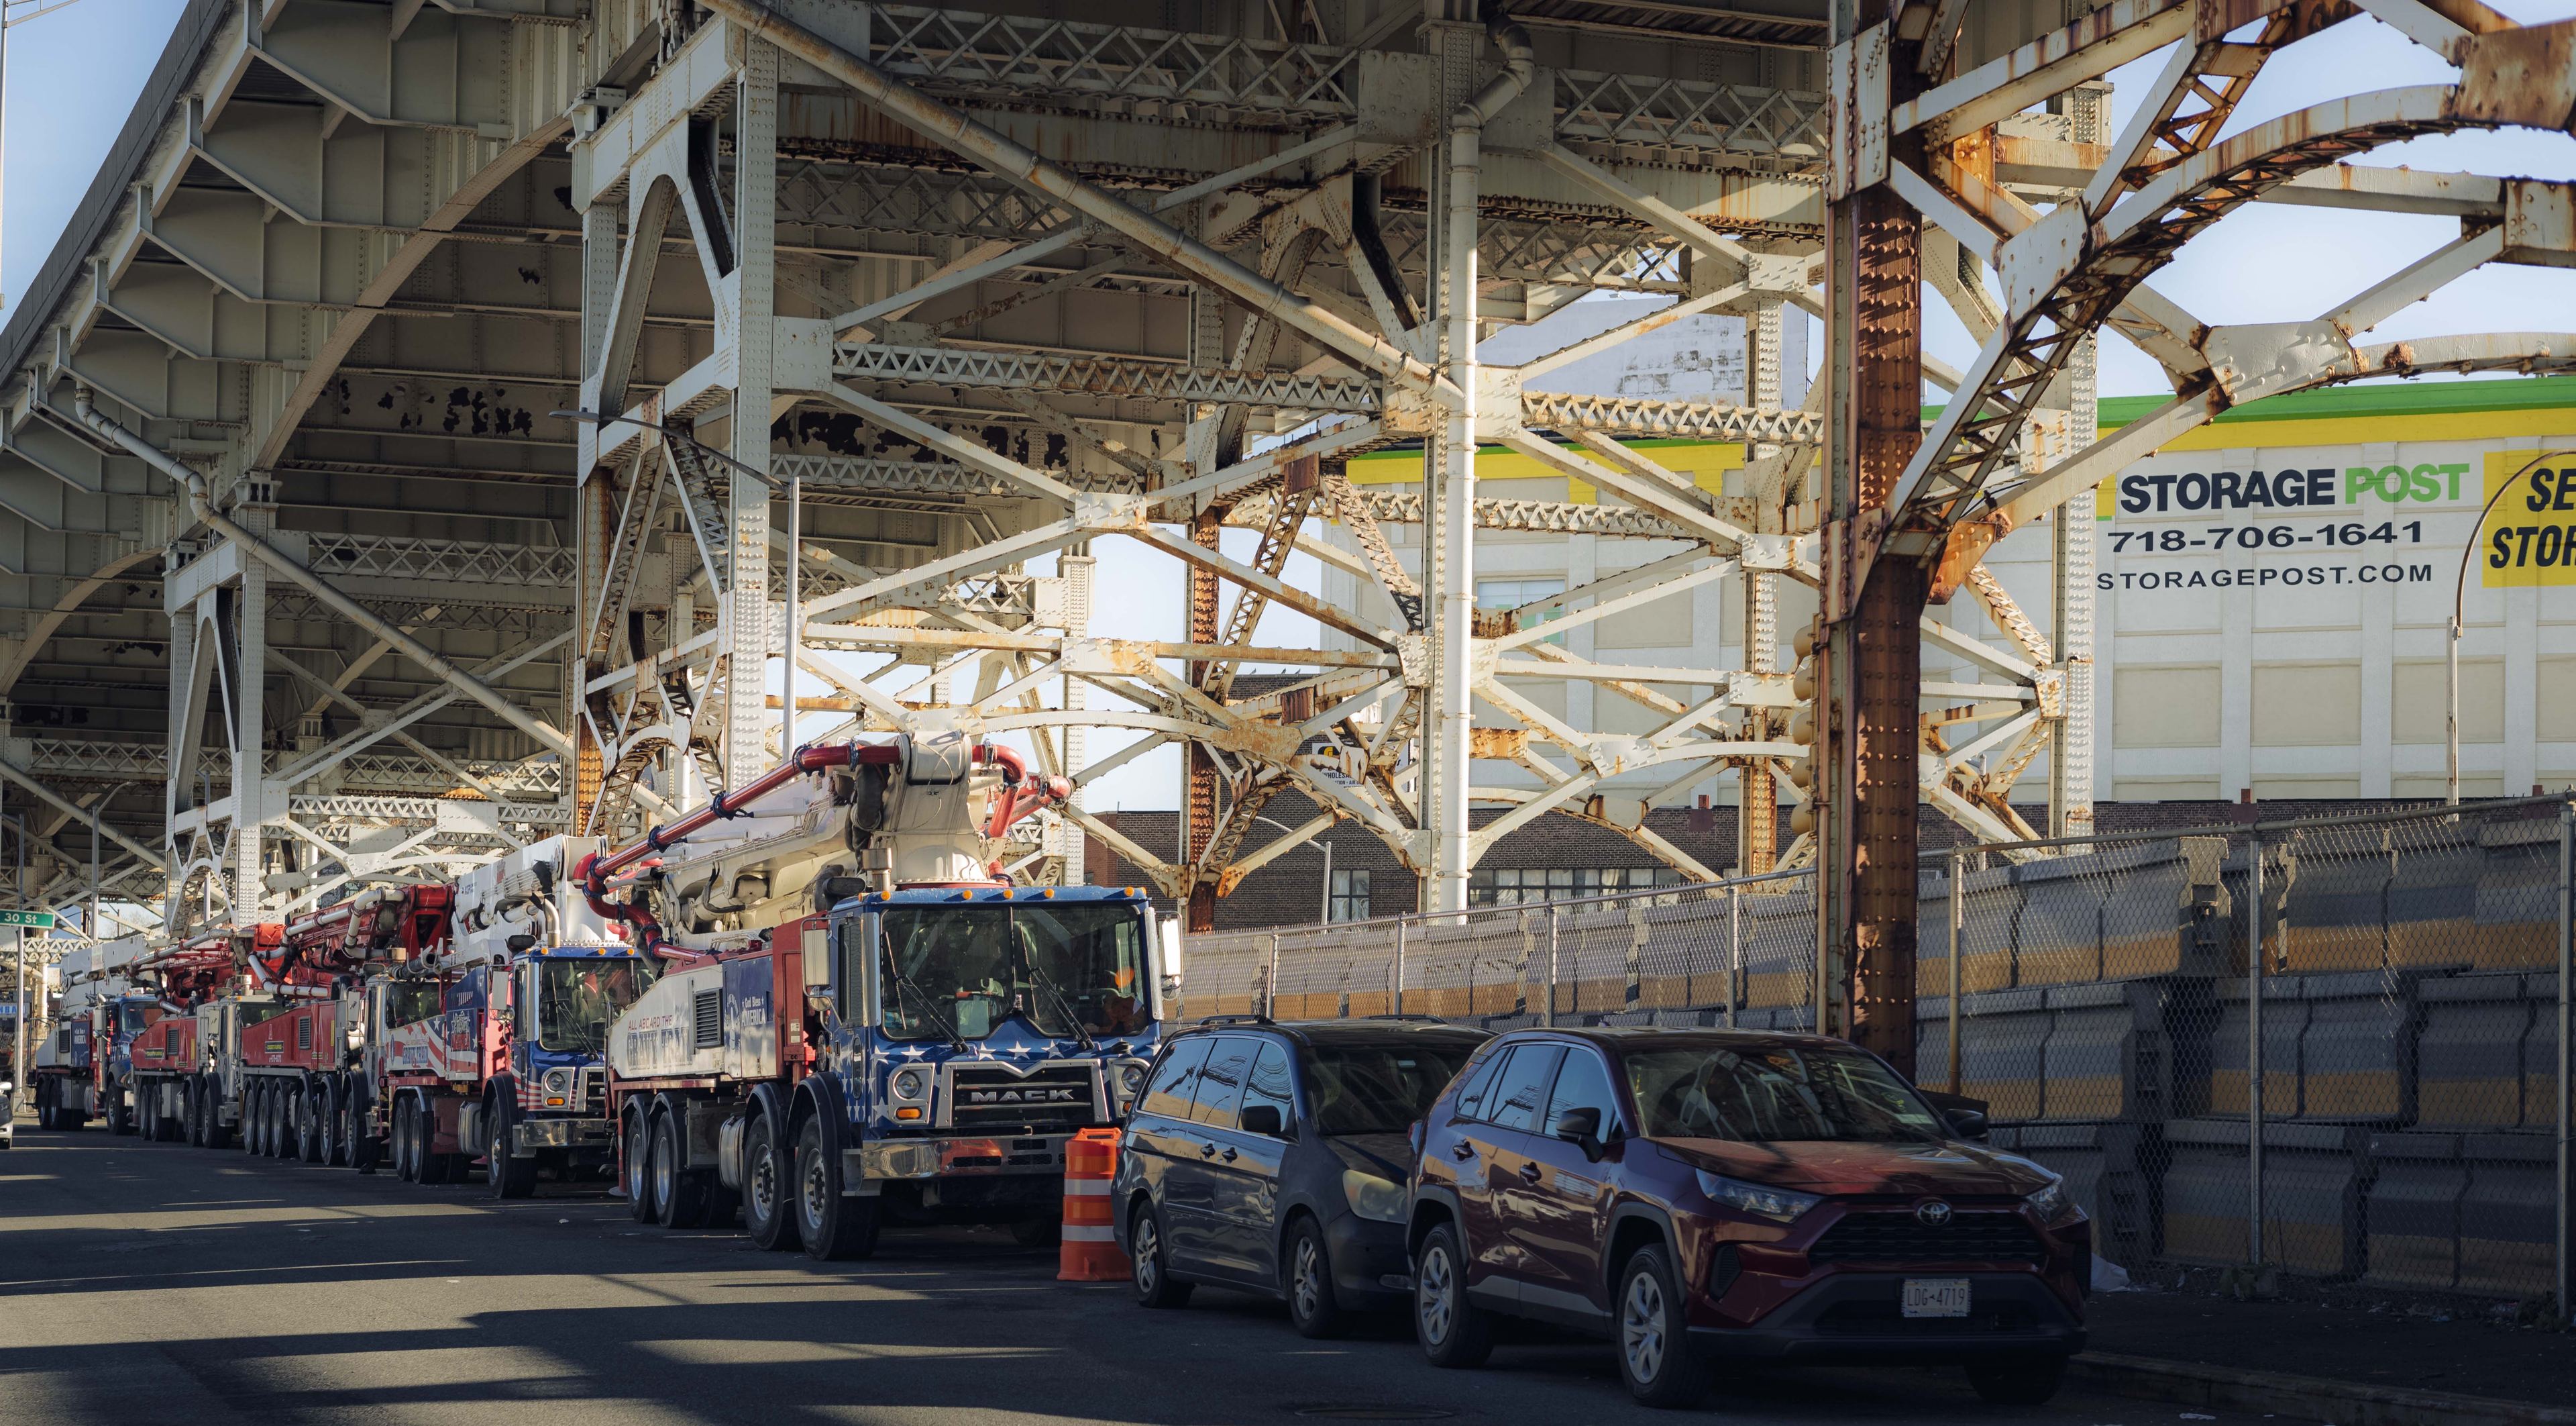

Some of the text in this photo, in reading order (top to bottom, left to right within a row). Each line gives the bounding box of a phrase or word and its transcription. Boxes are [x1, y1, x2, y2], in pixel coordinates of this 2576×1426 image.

[2121, 463, 2469, 513] STORAGE POST
[2527, 468, 2576, 512] SE
[2108, 521, 2422, 553] 718-706-1641
[2098, 565, 2432, 590] STORAGEPOST.COM
[4, 913, 37, 924] 30 St
[628, 1015, 672, 1031] ALL ABOARD THE
[741, 1008, 766, 1027] AMERICA
[971, 1089, 1074, 1102] MACK
